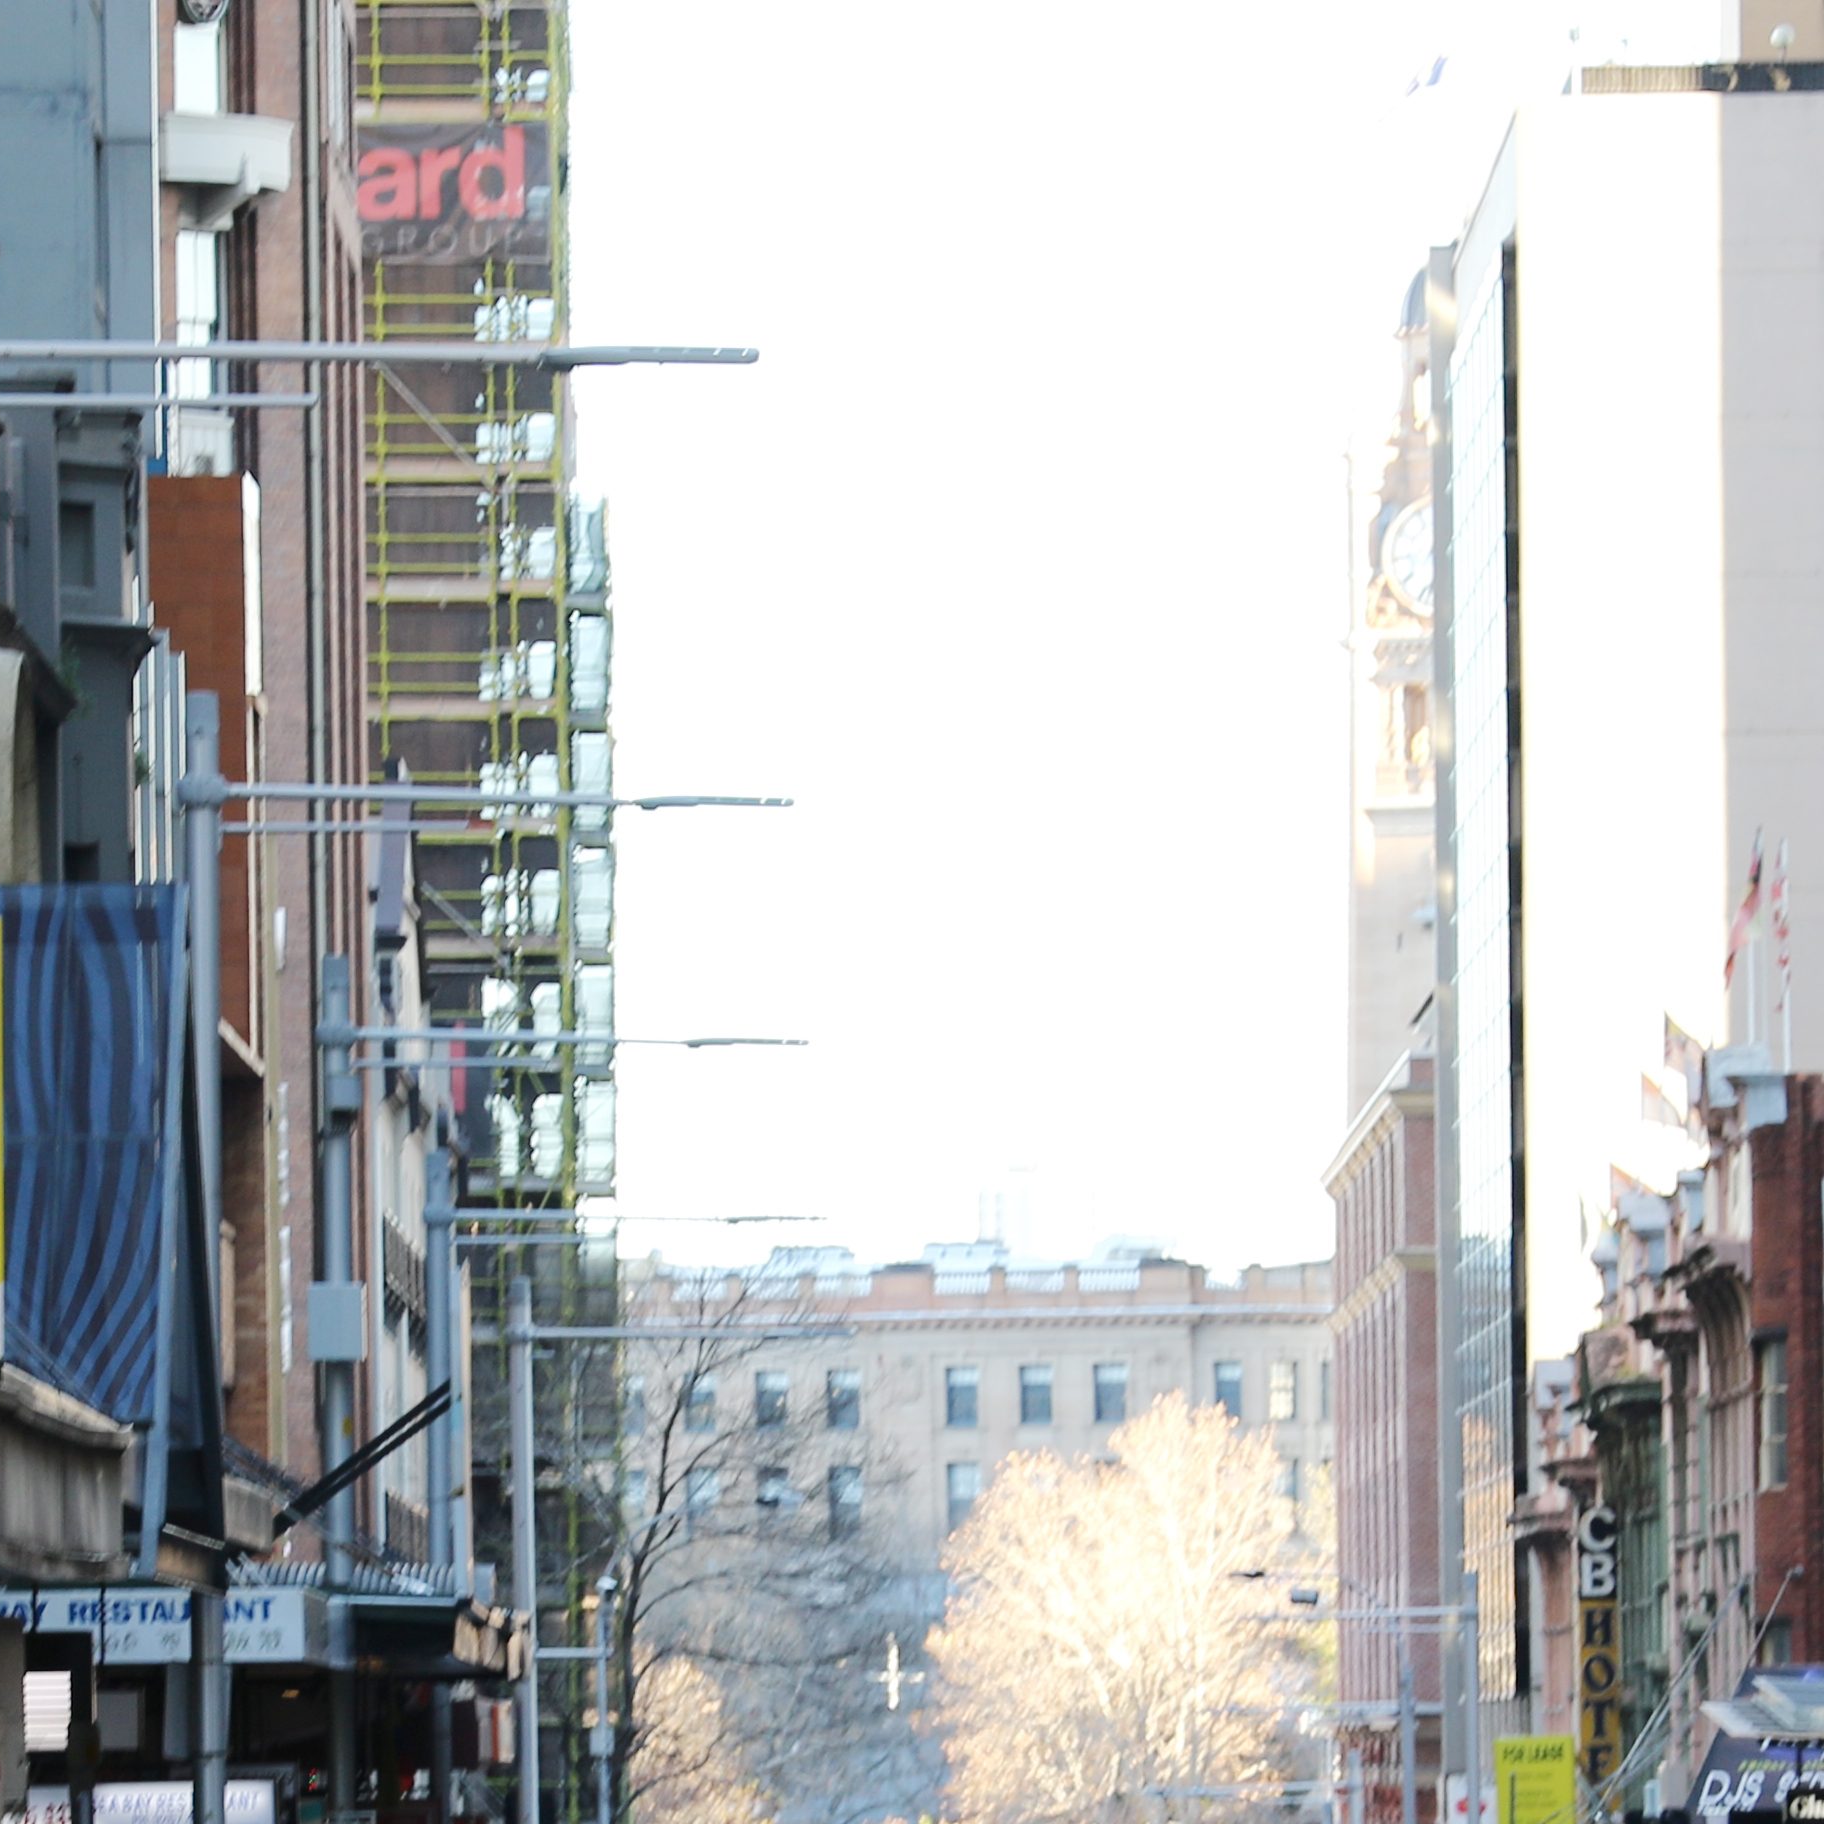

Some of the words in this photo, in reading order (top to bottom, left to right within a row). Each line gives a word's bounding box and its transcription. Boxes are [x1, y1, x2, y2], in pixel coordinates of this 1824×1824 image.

[356, 125, 525, 221] ard
[361, 223, 523, 258] GROUP
[67, 1597, 277, 1627] RESTAUANT
